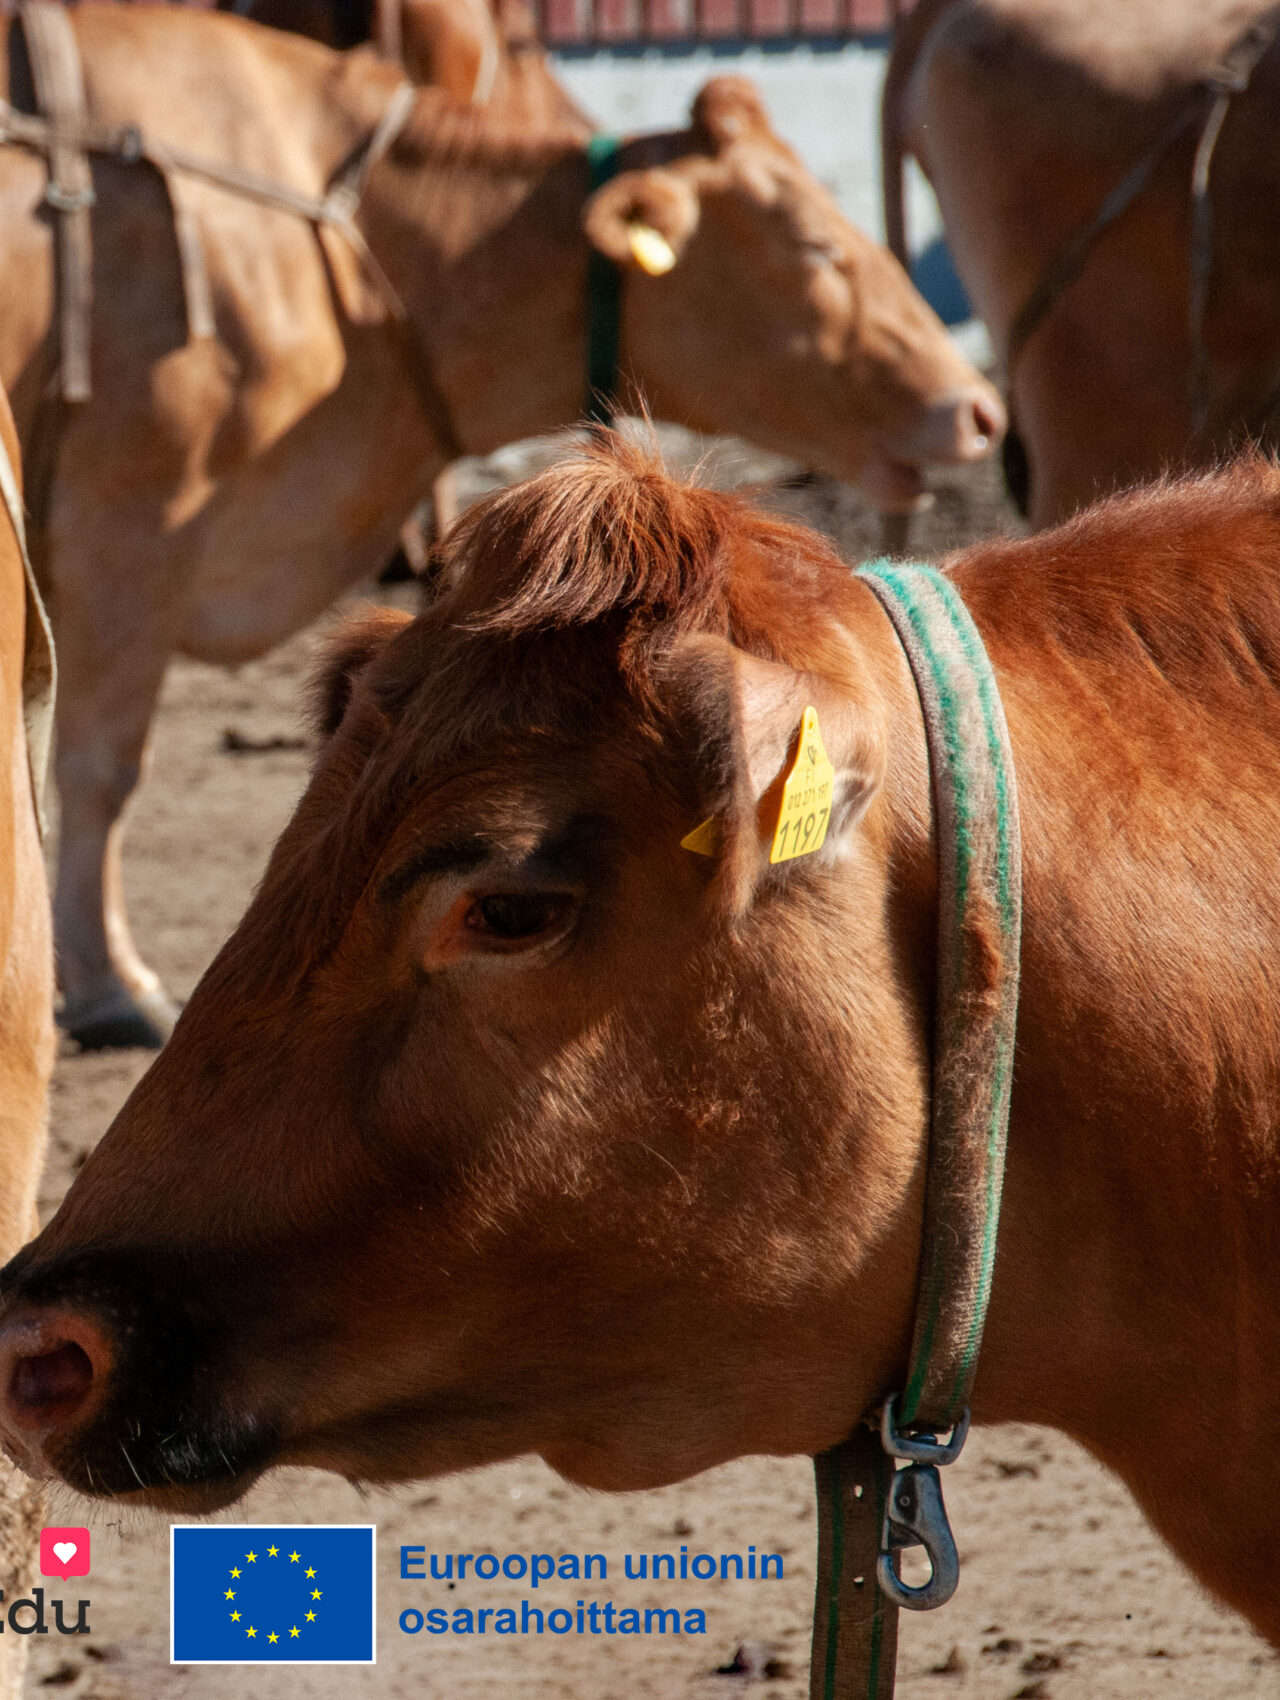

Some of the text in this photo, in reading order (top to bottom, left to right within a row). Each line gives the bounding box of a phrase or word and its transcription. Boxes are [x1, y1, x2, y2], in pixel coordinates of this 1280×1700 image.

[806, 769, 815, 782] FI
[788, 783, 828, 810] 012 271 197
[778, 807, 828, 858] 1197
